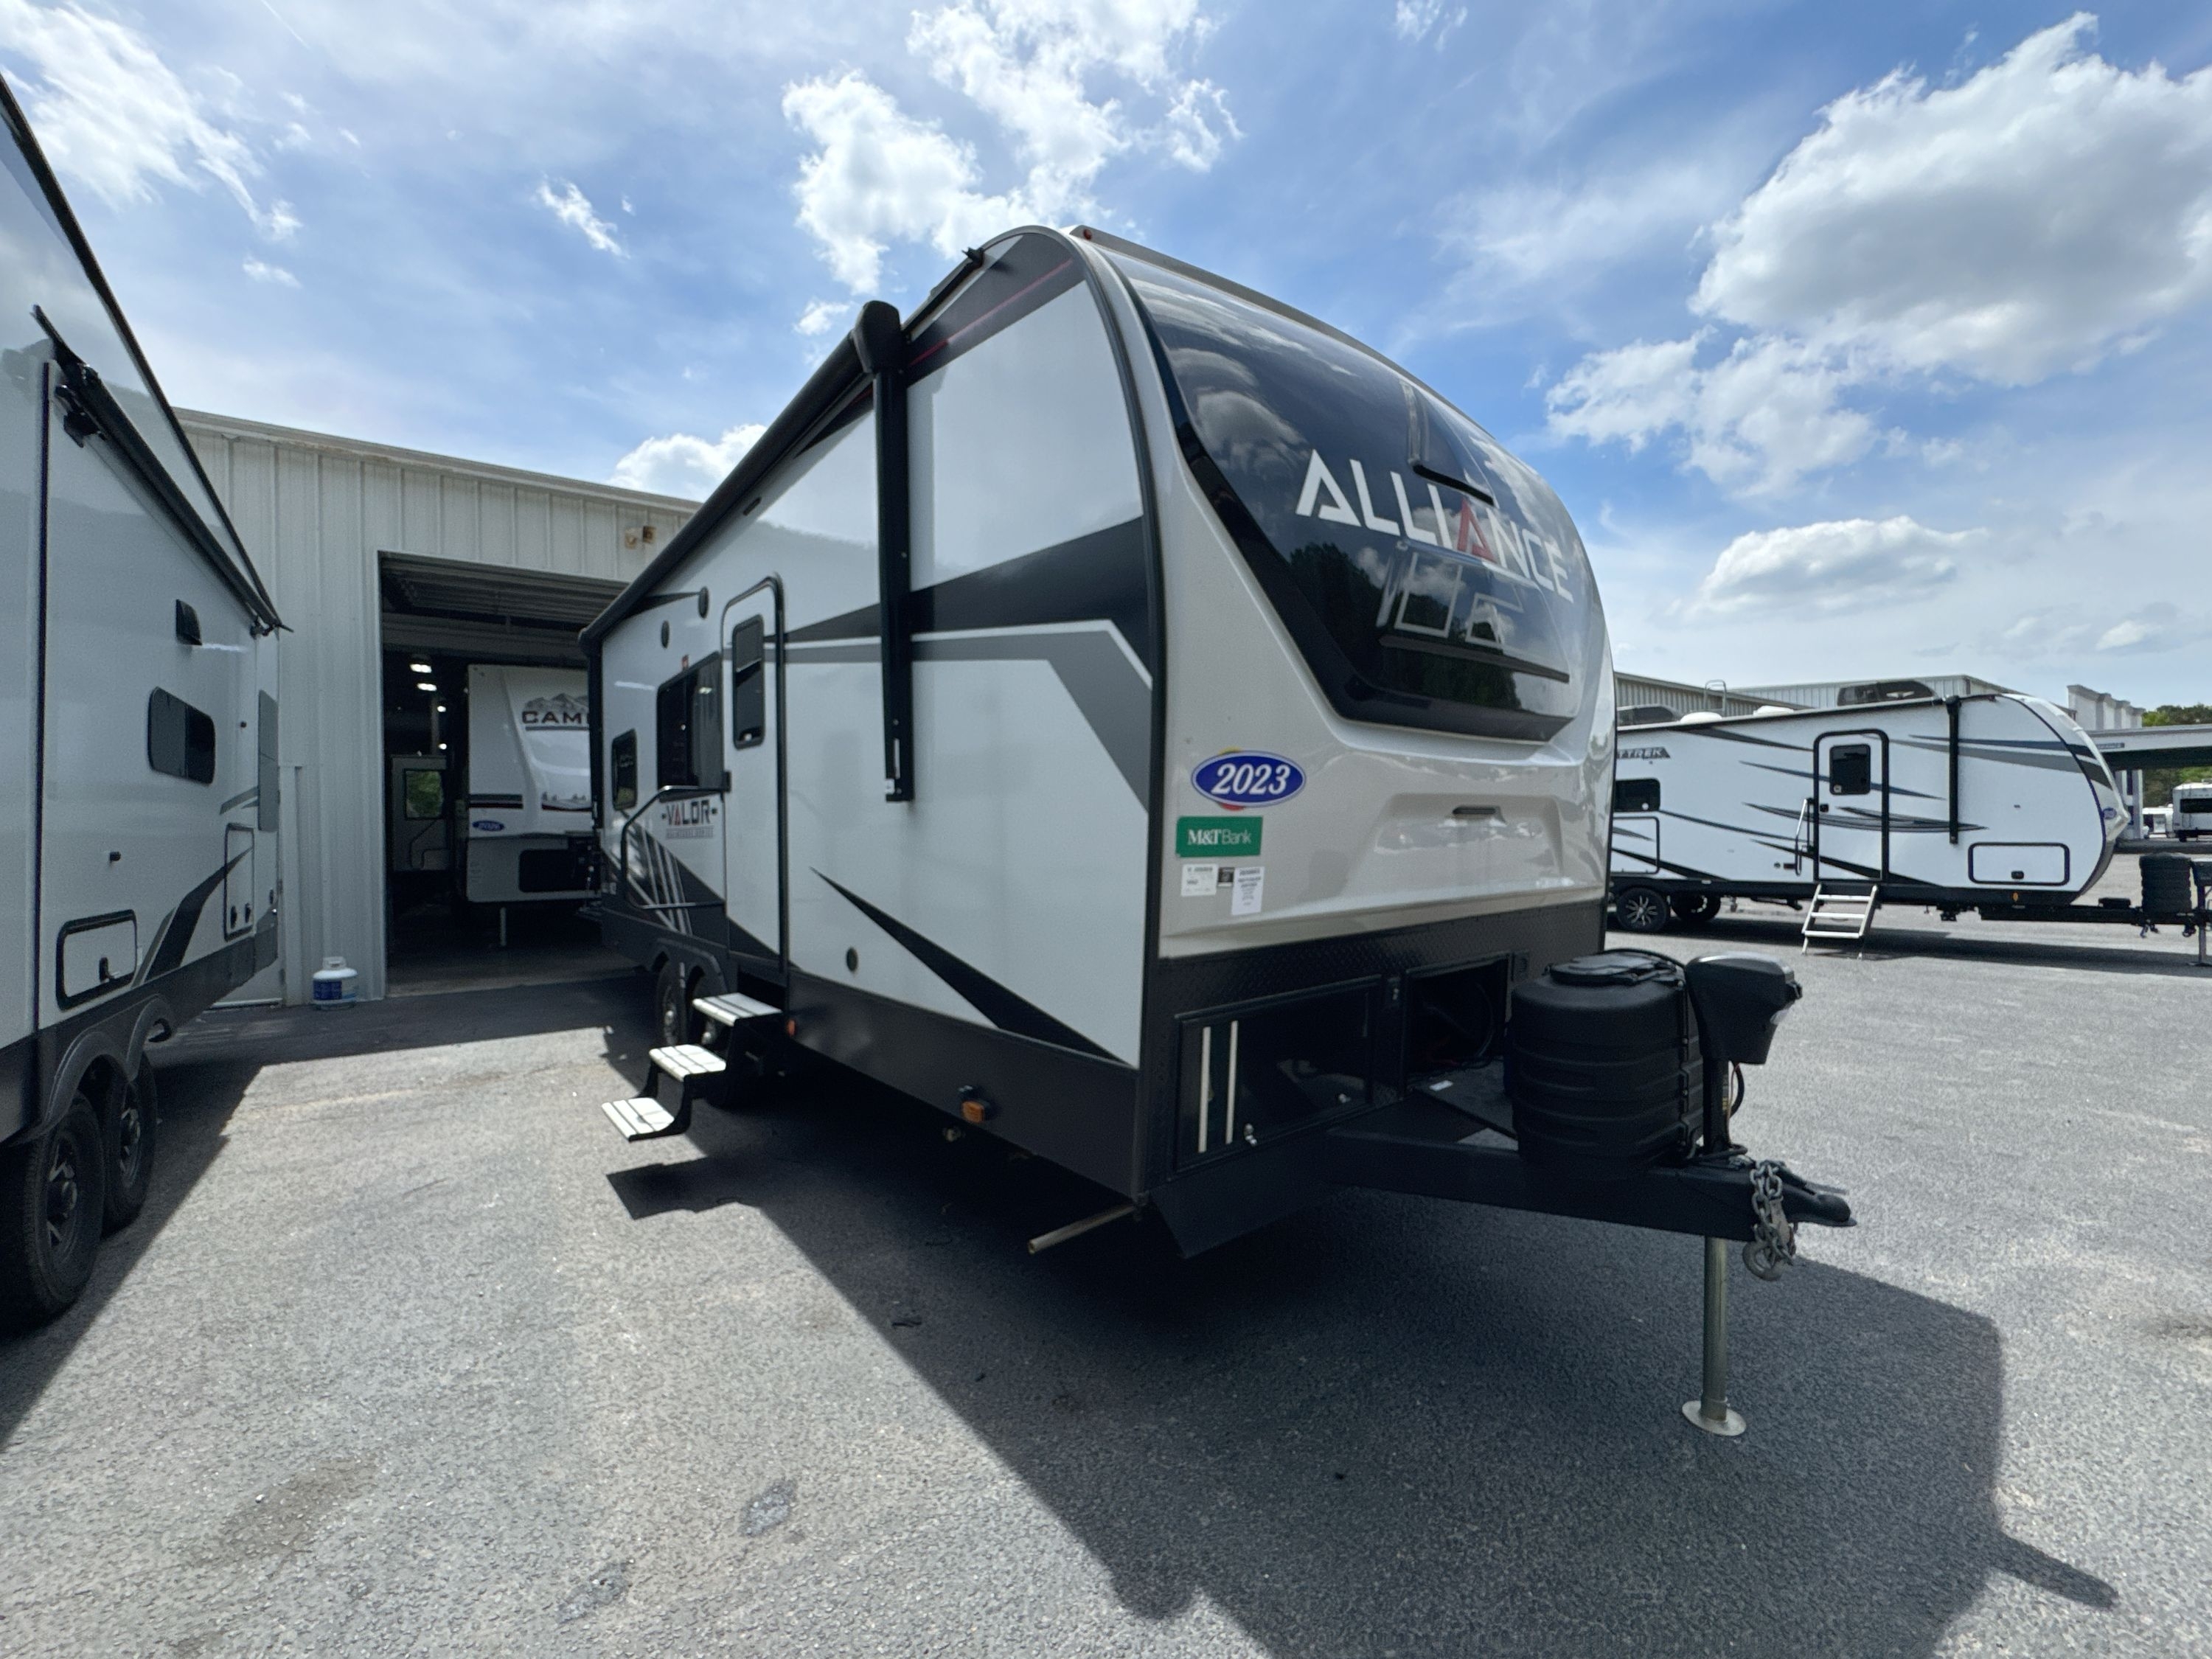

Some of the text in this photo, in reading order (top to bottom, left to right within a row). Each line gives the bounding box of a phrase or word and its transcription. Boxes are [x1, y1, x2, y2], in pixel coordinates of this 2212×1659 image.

[1295, 449, 1573, 603] ALLIANCE
[522, 711, 588, 724] CAM
[1617, 748, 1663, 759] TTREK
[1211, 763, 1291, 796] 2023
[667, 800, 710, 826] VALOR
[1187, 829, 1252, 846] M&T Bank
